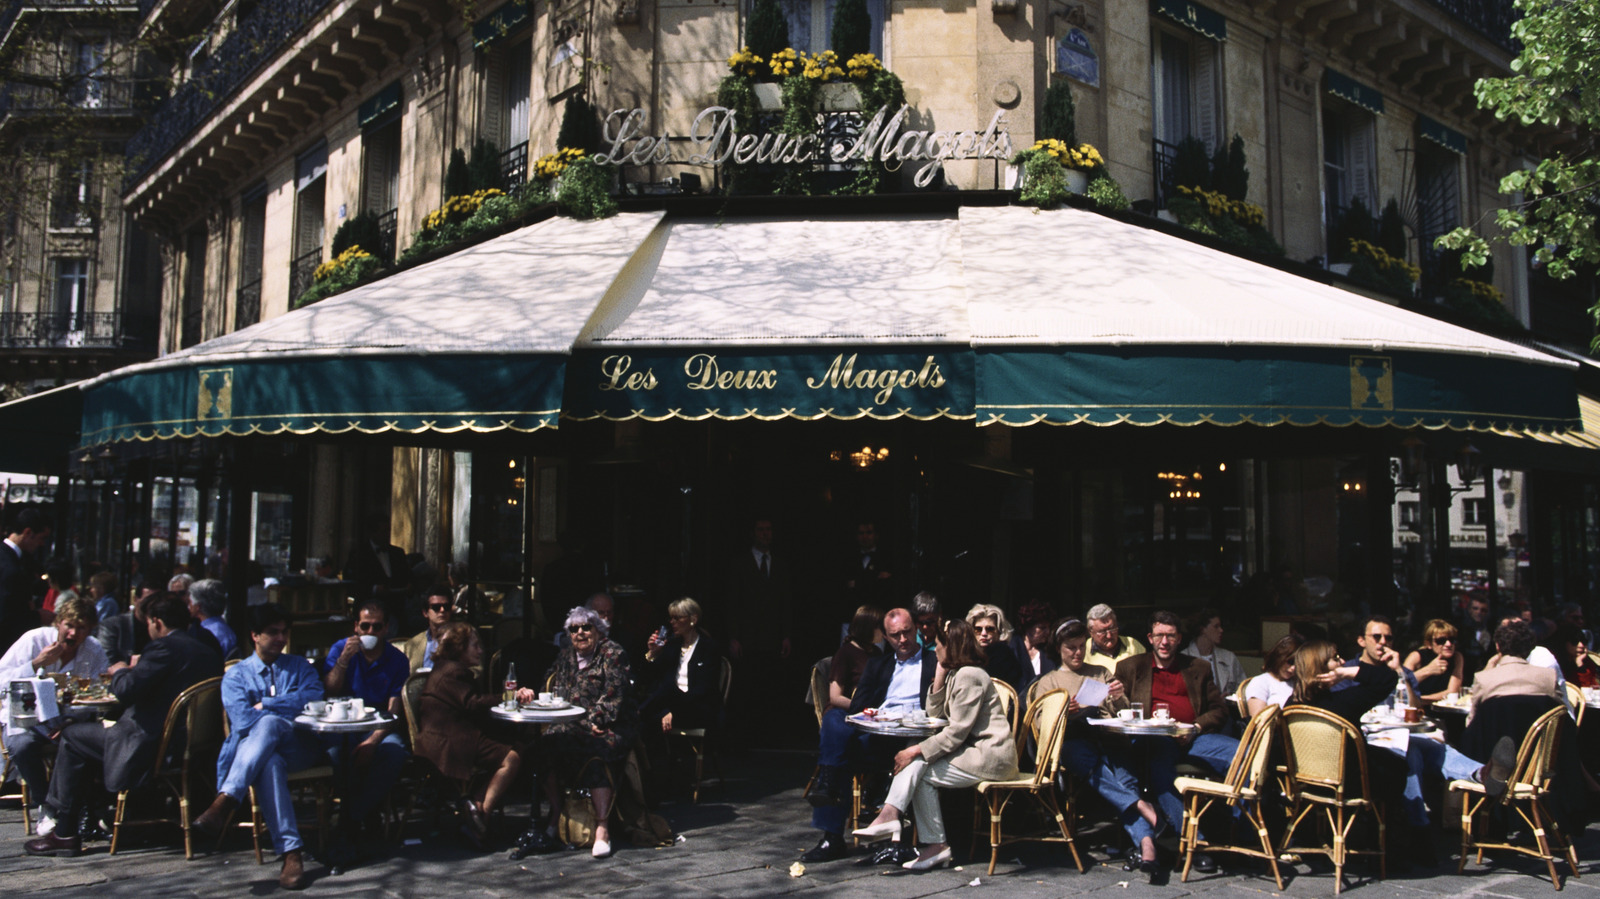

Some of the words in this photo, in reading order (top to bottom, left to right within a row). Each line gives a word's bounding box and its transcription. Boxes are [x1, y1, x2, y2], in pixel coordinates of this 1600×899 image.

[594, 107, 670, 166] Les
[689, 106, 817, 166] Deux
[831, 103, 1013, 188] Magots
[599, 354, 658, 391] Les
[684, 353, 778, 391] Deux
[806, 352, 946, 405] Magots
